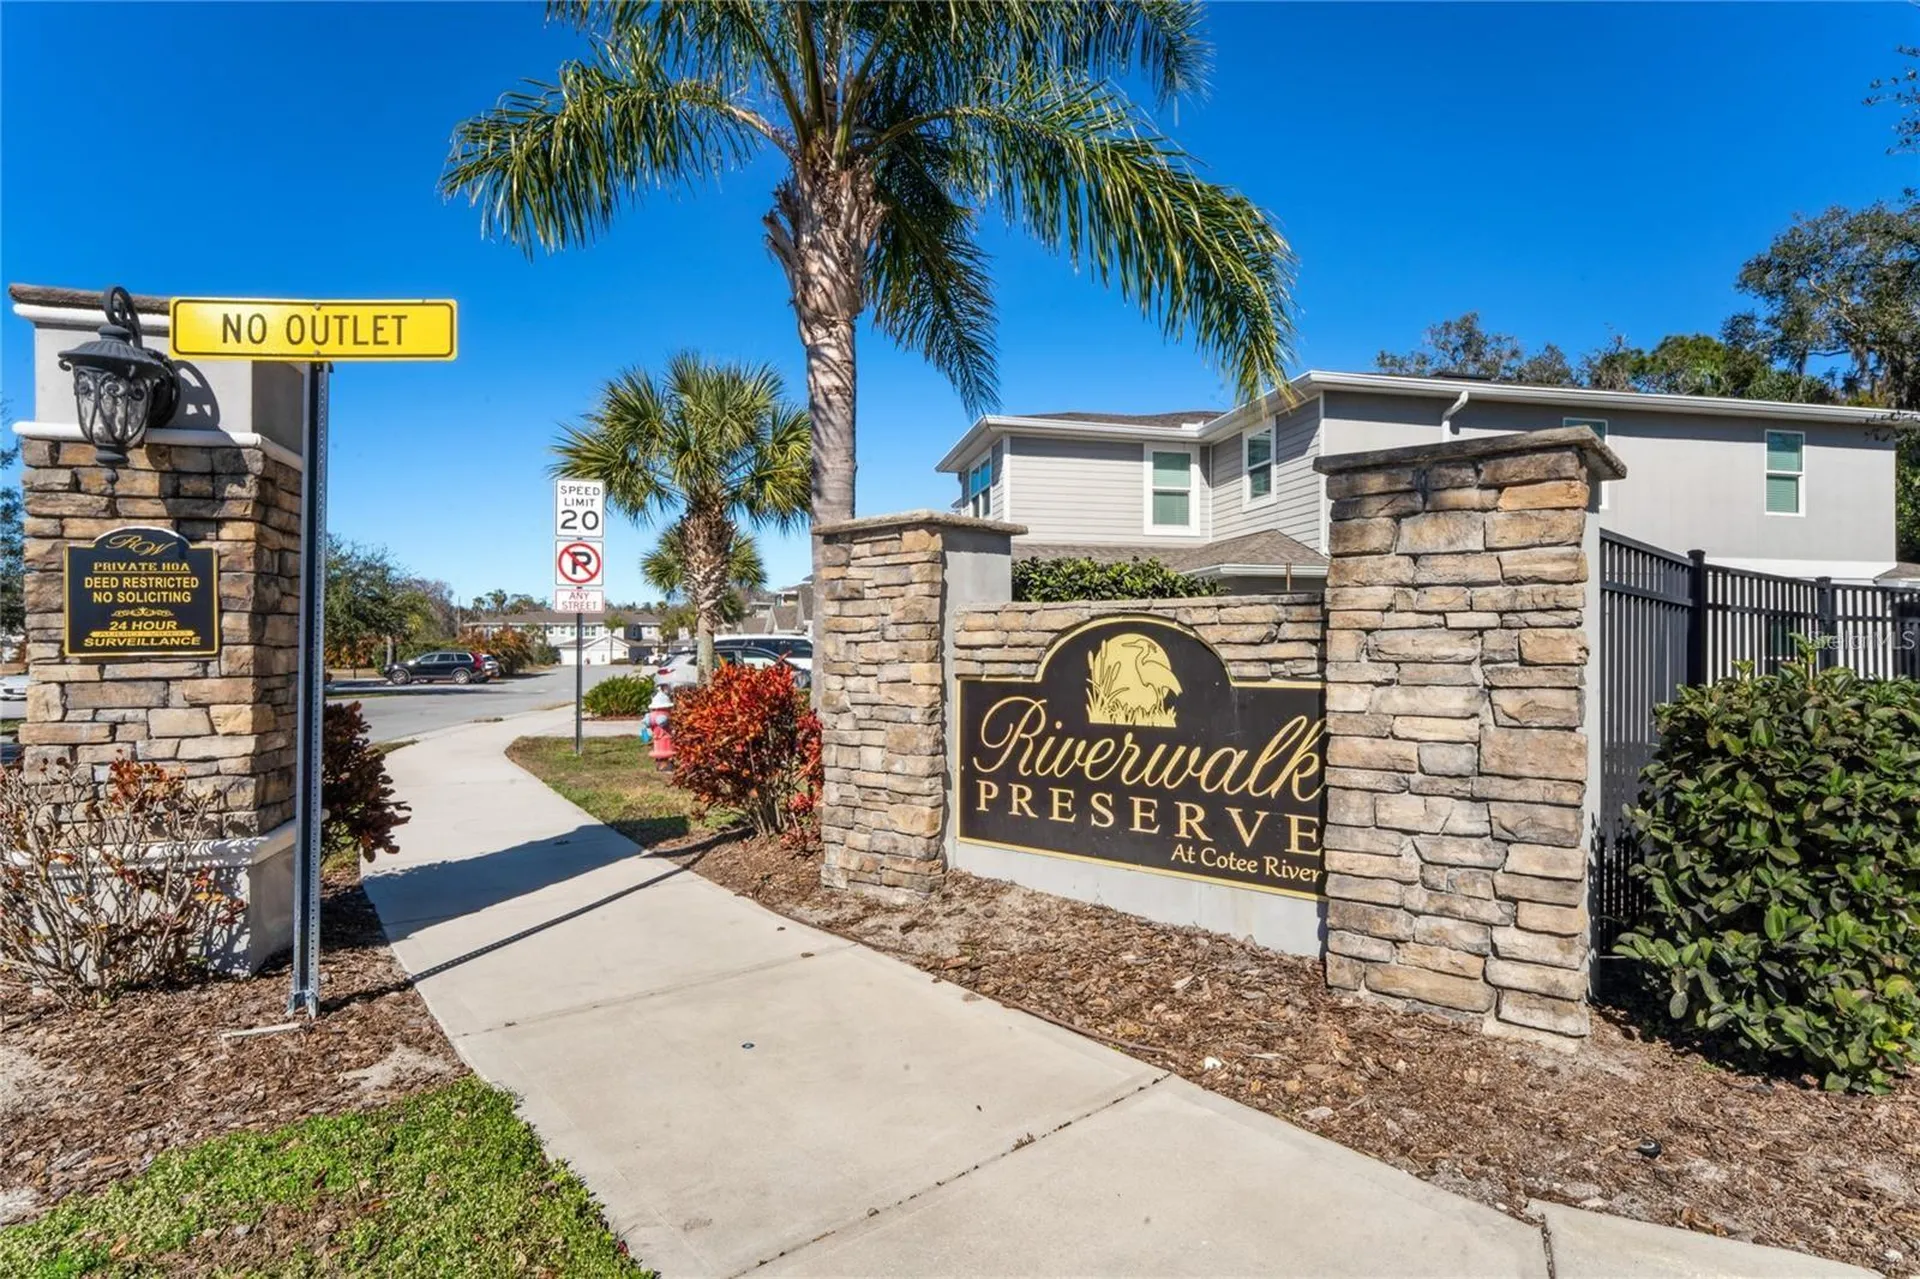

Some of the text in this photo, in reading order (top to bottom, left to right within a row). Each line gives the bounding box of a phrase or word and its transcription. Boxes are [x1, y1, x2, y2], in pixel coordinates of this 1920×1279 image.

[222, 313, 408, 346] NO OUTLET
[560, 485, 600, 496] SPEED
[564, 498, 595, 507] LIMIT
[560, 509, 599, 531] 20
[93, 562, 190, 571] PRIVATE HOA
[84, 577, 199, 589] DEED RESTRICTED
[93, 591, 192, 604] NO SOLICITING
[569, 591, 589, 601] ANY
[562, 600, 597, 611] STREET
[109, 620, 178, 631] 24 HOUR
[84, 636, 202, 648] SURVEILLANCE
[972, 695, 1326, 802] Riverwalk
[975, 779, 1322, 856] PRESERVE
[1170, 843, 1323, 883] At Cotee River
